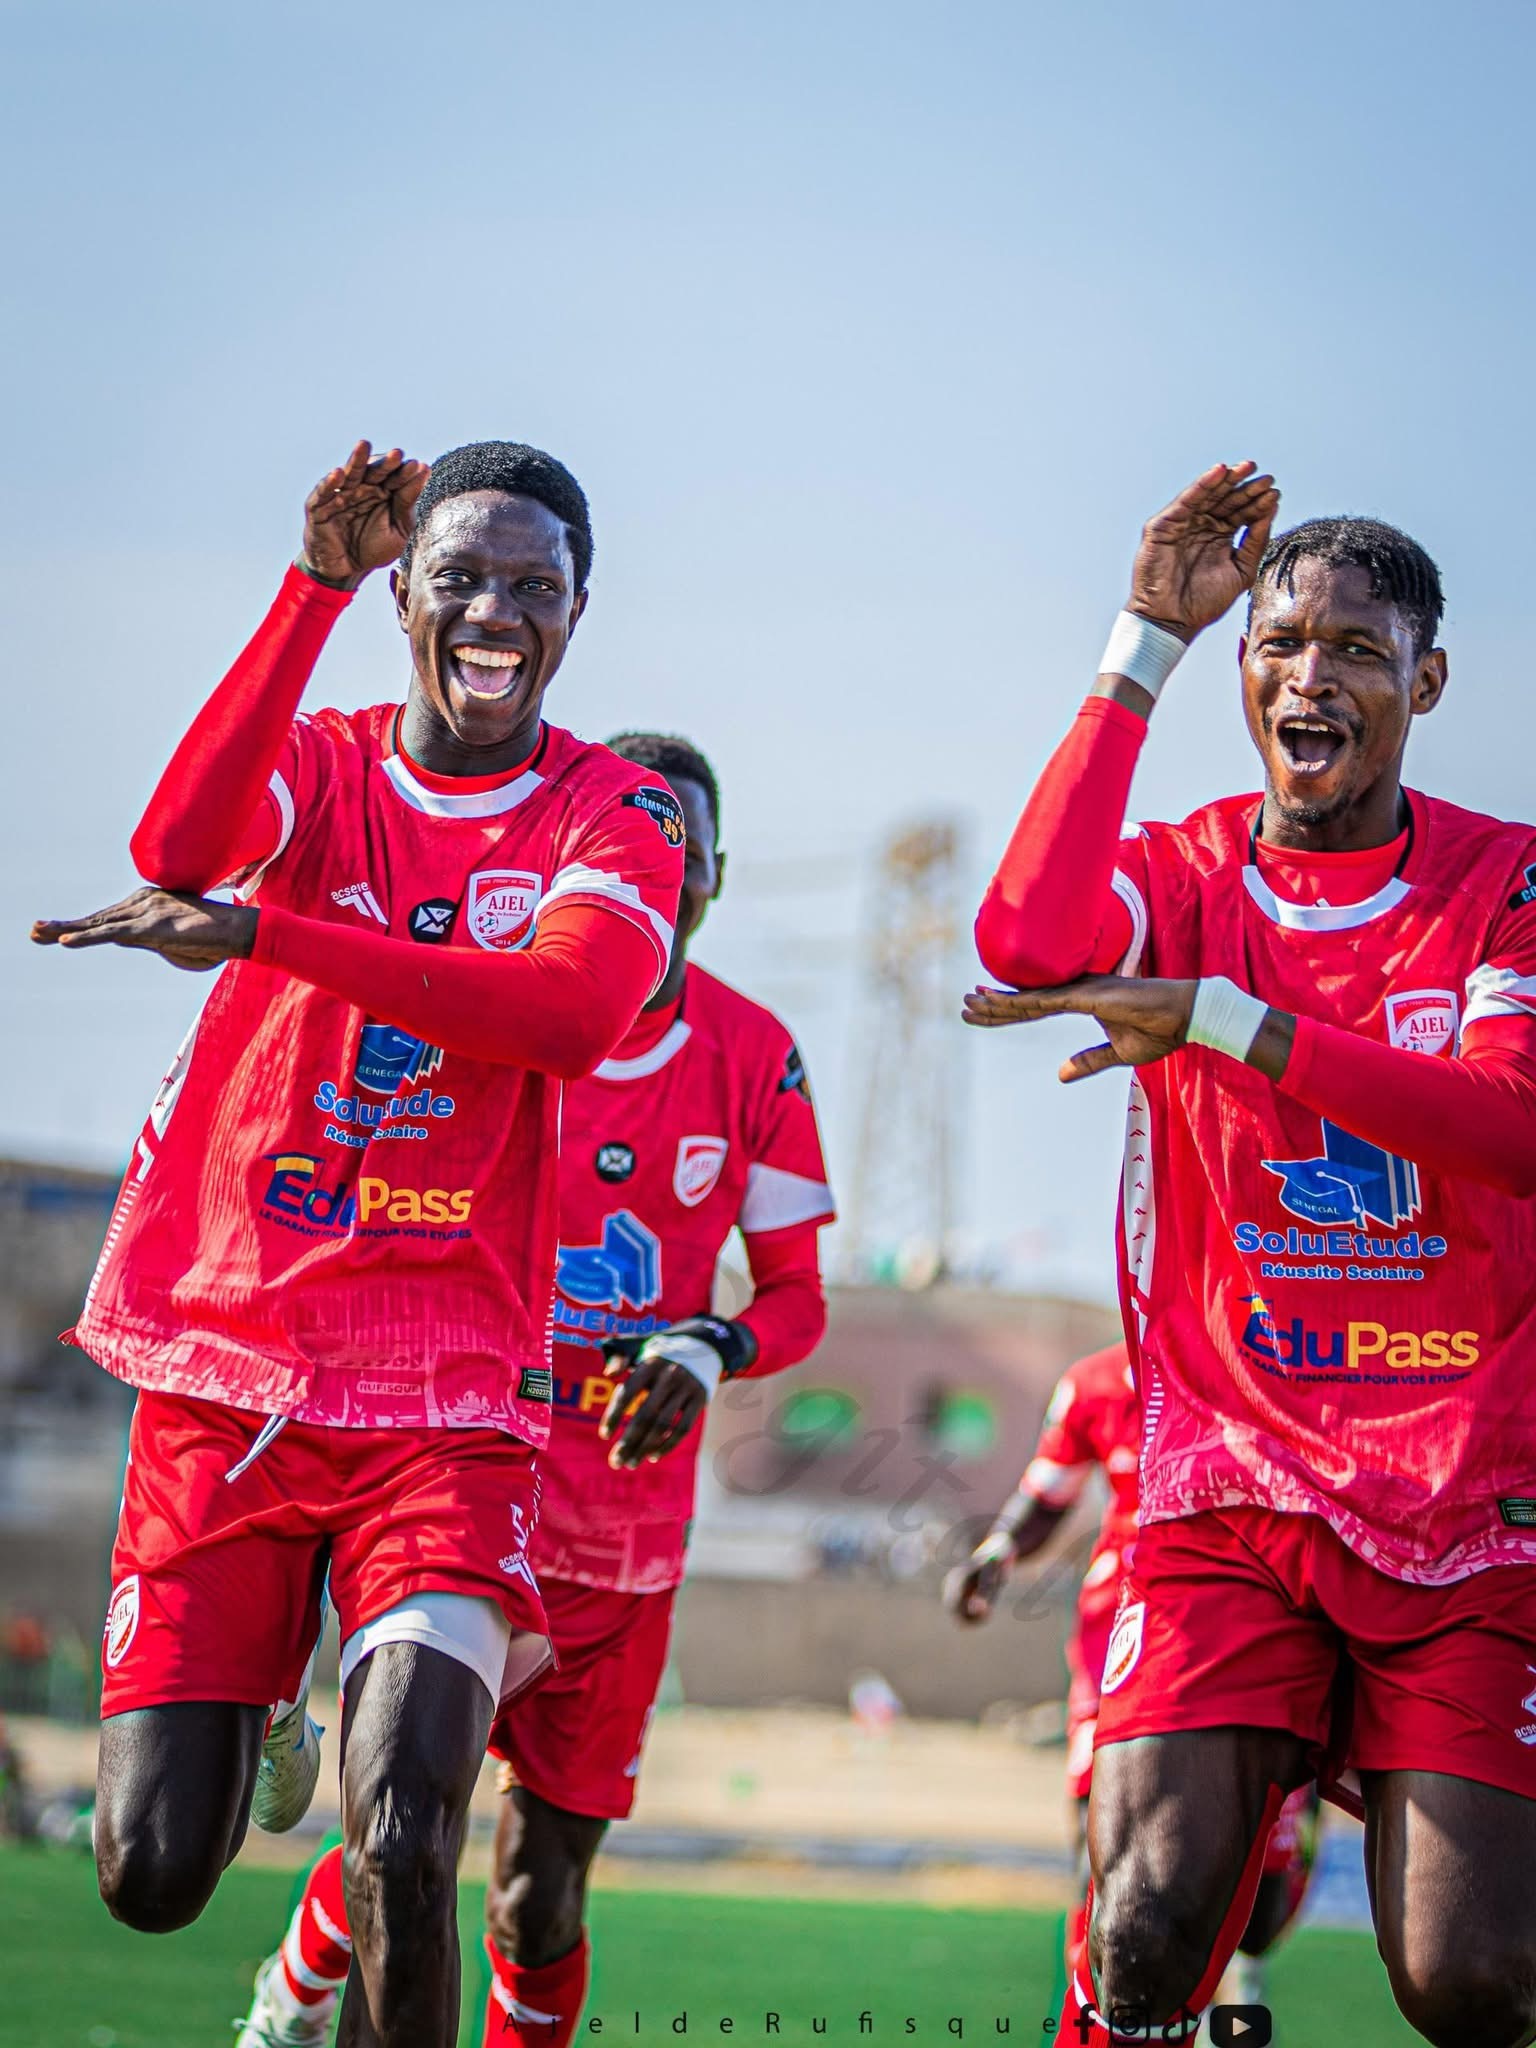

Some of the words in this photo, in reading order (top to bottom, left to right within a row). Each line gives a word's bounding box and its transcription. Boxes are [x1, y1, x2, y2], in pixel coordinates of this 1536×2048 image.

[488, 895, 528, 911] AJEL
[1410, 1016, 1448, 1034] AJEL
[358, 1064, 403, 1080] SENEGA
[1291, 1197, 1341, 1215] SENEGAL
[1234, 1221, 1448, 1259] SoluEtude
[1261, 1262, 1343, 1281] Réussite
[1346, 1265, 1425, 1281] Scolaire
[359, 1381, 420, 1394] RUFISQUE
[1364, 1373, 1398, 1385] POUR
[1402, 1373, 1426, 1385] VOS
